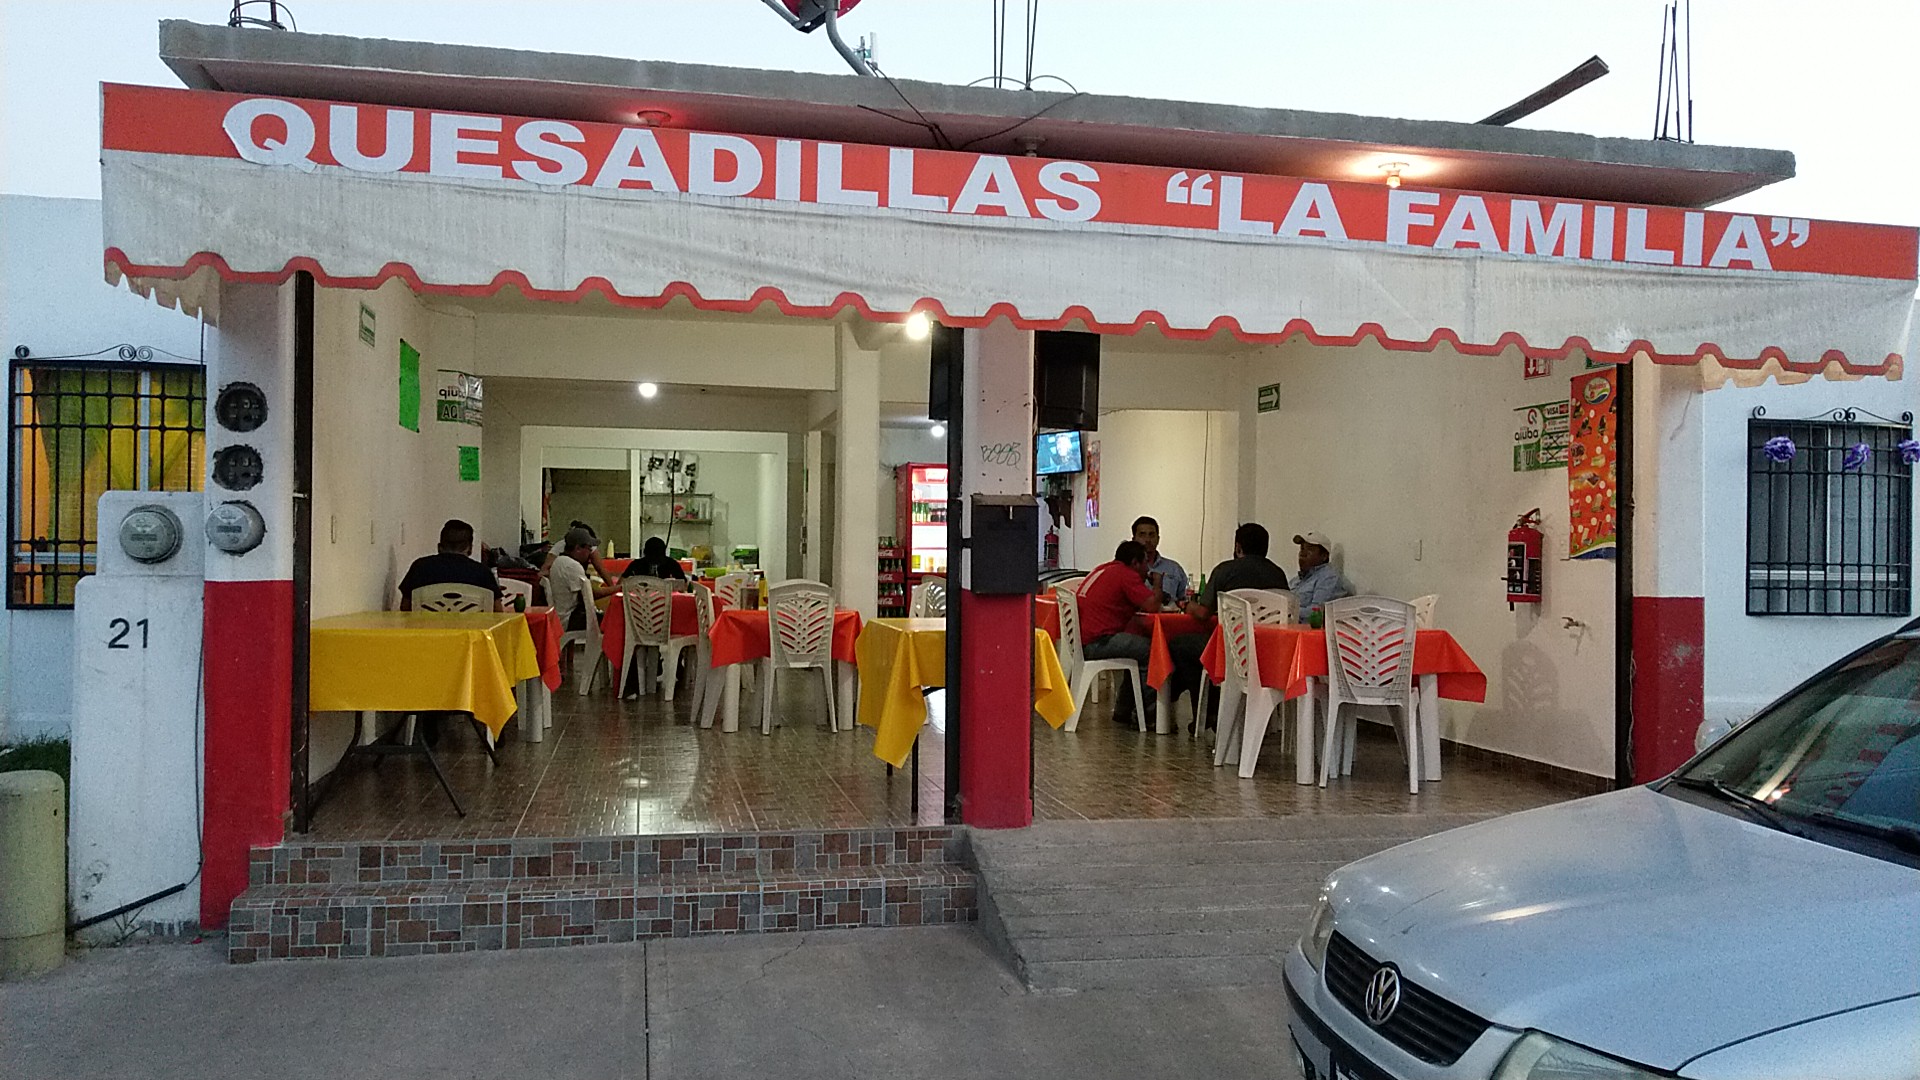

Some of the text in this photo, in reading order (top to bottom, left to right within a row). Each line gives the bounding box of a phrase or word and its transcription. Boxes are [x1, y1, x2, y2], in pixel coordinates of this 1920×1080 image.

[223, 98, 1810, 270] QUESADILLAS “LA FAMILIA”
[439, 385, 466, 399] qiu
[1546, 406, 1559, 416] VISA
[108, 617, 149, 649] 21
